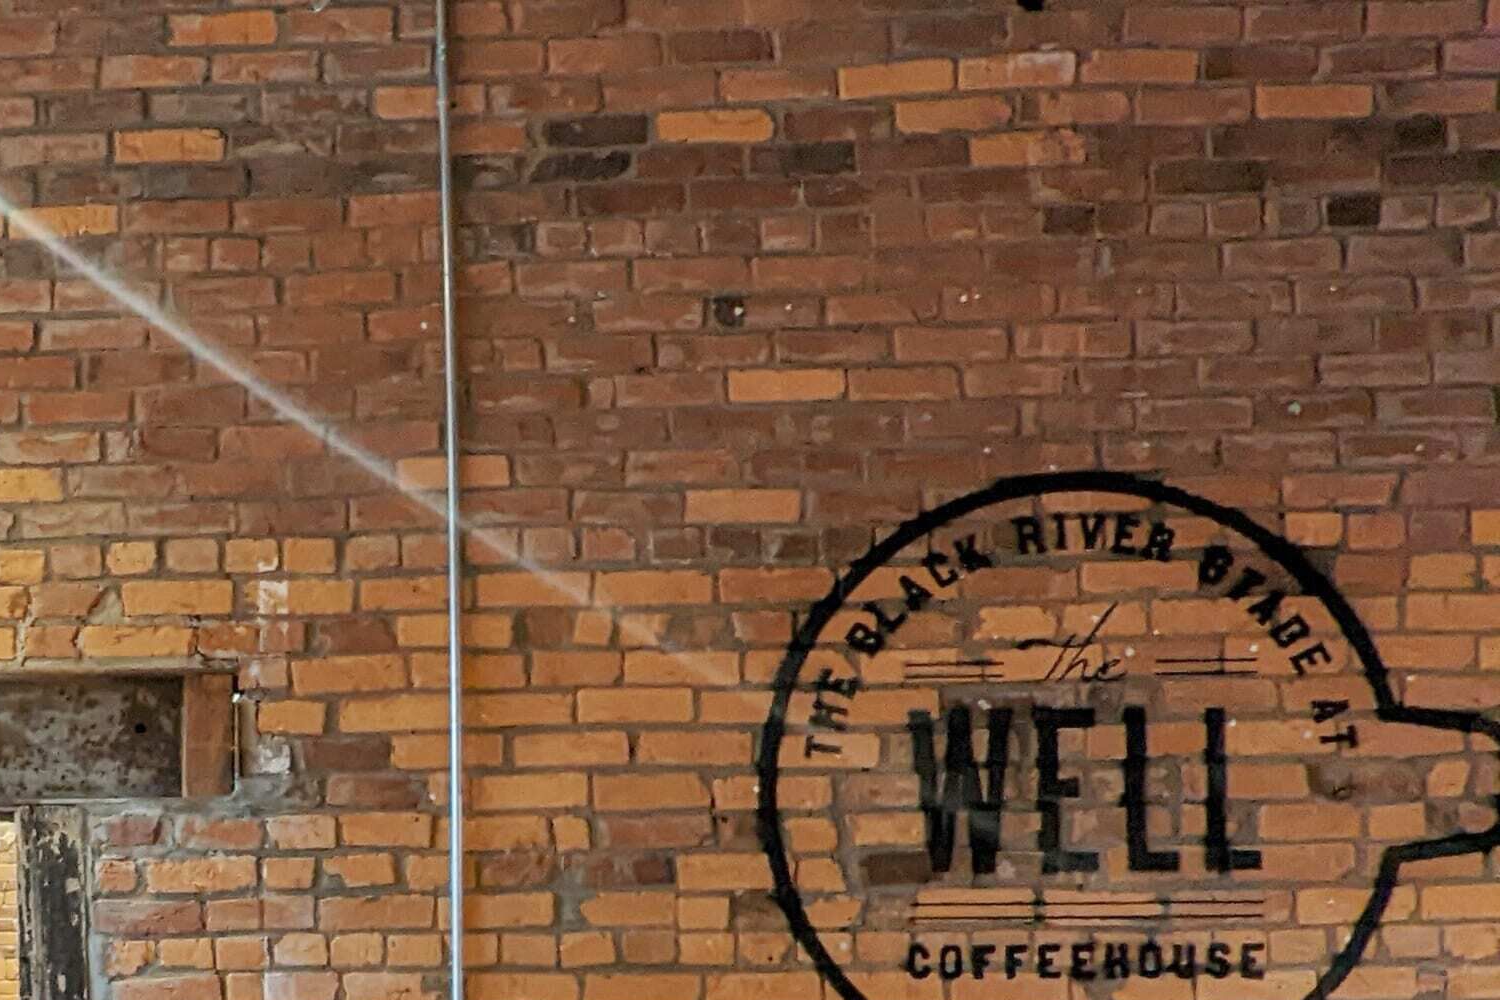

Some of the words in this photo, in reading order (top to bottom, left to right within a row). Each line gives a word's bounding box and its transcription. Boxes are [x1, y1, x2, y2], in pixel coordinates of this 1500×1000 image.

[804, 668, 861, 759] THE
[845, 534, 992, 656] BLACK
[1011, 512, 1176, 562] RIVER
[1311, 700, 1359, 749] AT
[1011, 602, 1129, 682] the
[905, 704, 1263, 874] WELL
[904, 941, 1266, 981] COFFEEHOUSE
